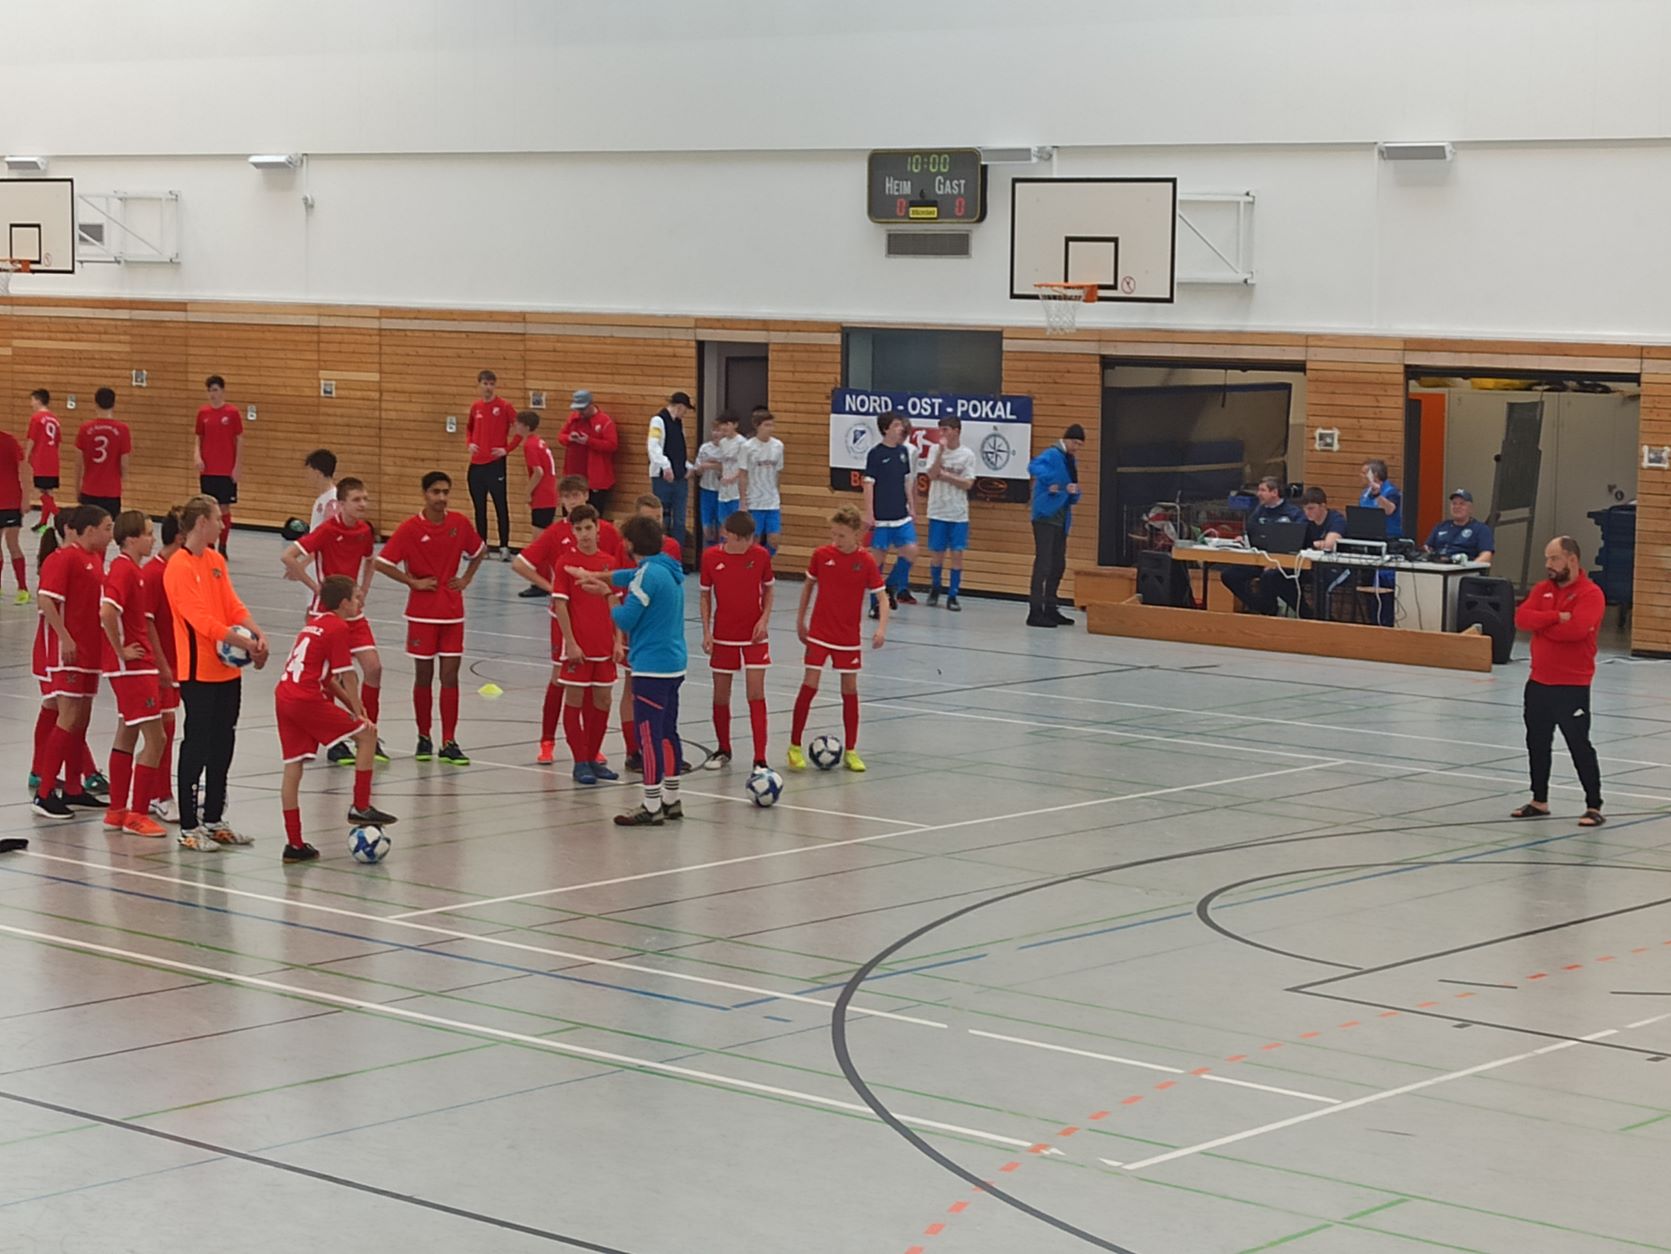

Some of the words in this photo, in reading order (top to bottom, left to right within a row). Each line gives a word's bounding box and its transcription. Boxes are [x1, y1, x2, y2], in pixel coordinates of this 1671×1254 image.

[907, 154, 949, 172] 10:00
[896, 198, 906, 216] 0
[954, 196, 965, 216] 0
[845, 394, 892, 413] NORD
[907, 397, 943, 415] OST
[957, 399, 1017, 419] POKAL
[46, 422, 56, 446] 9
[92, 435, 108, 463] 3
